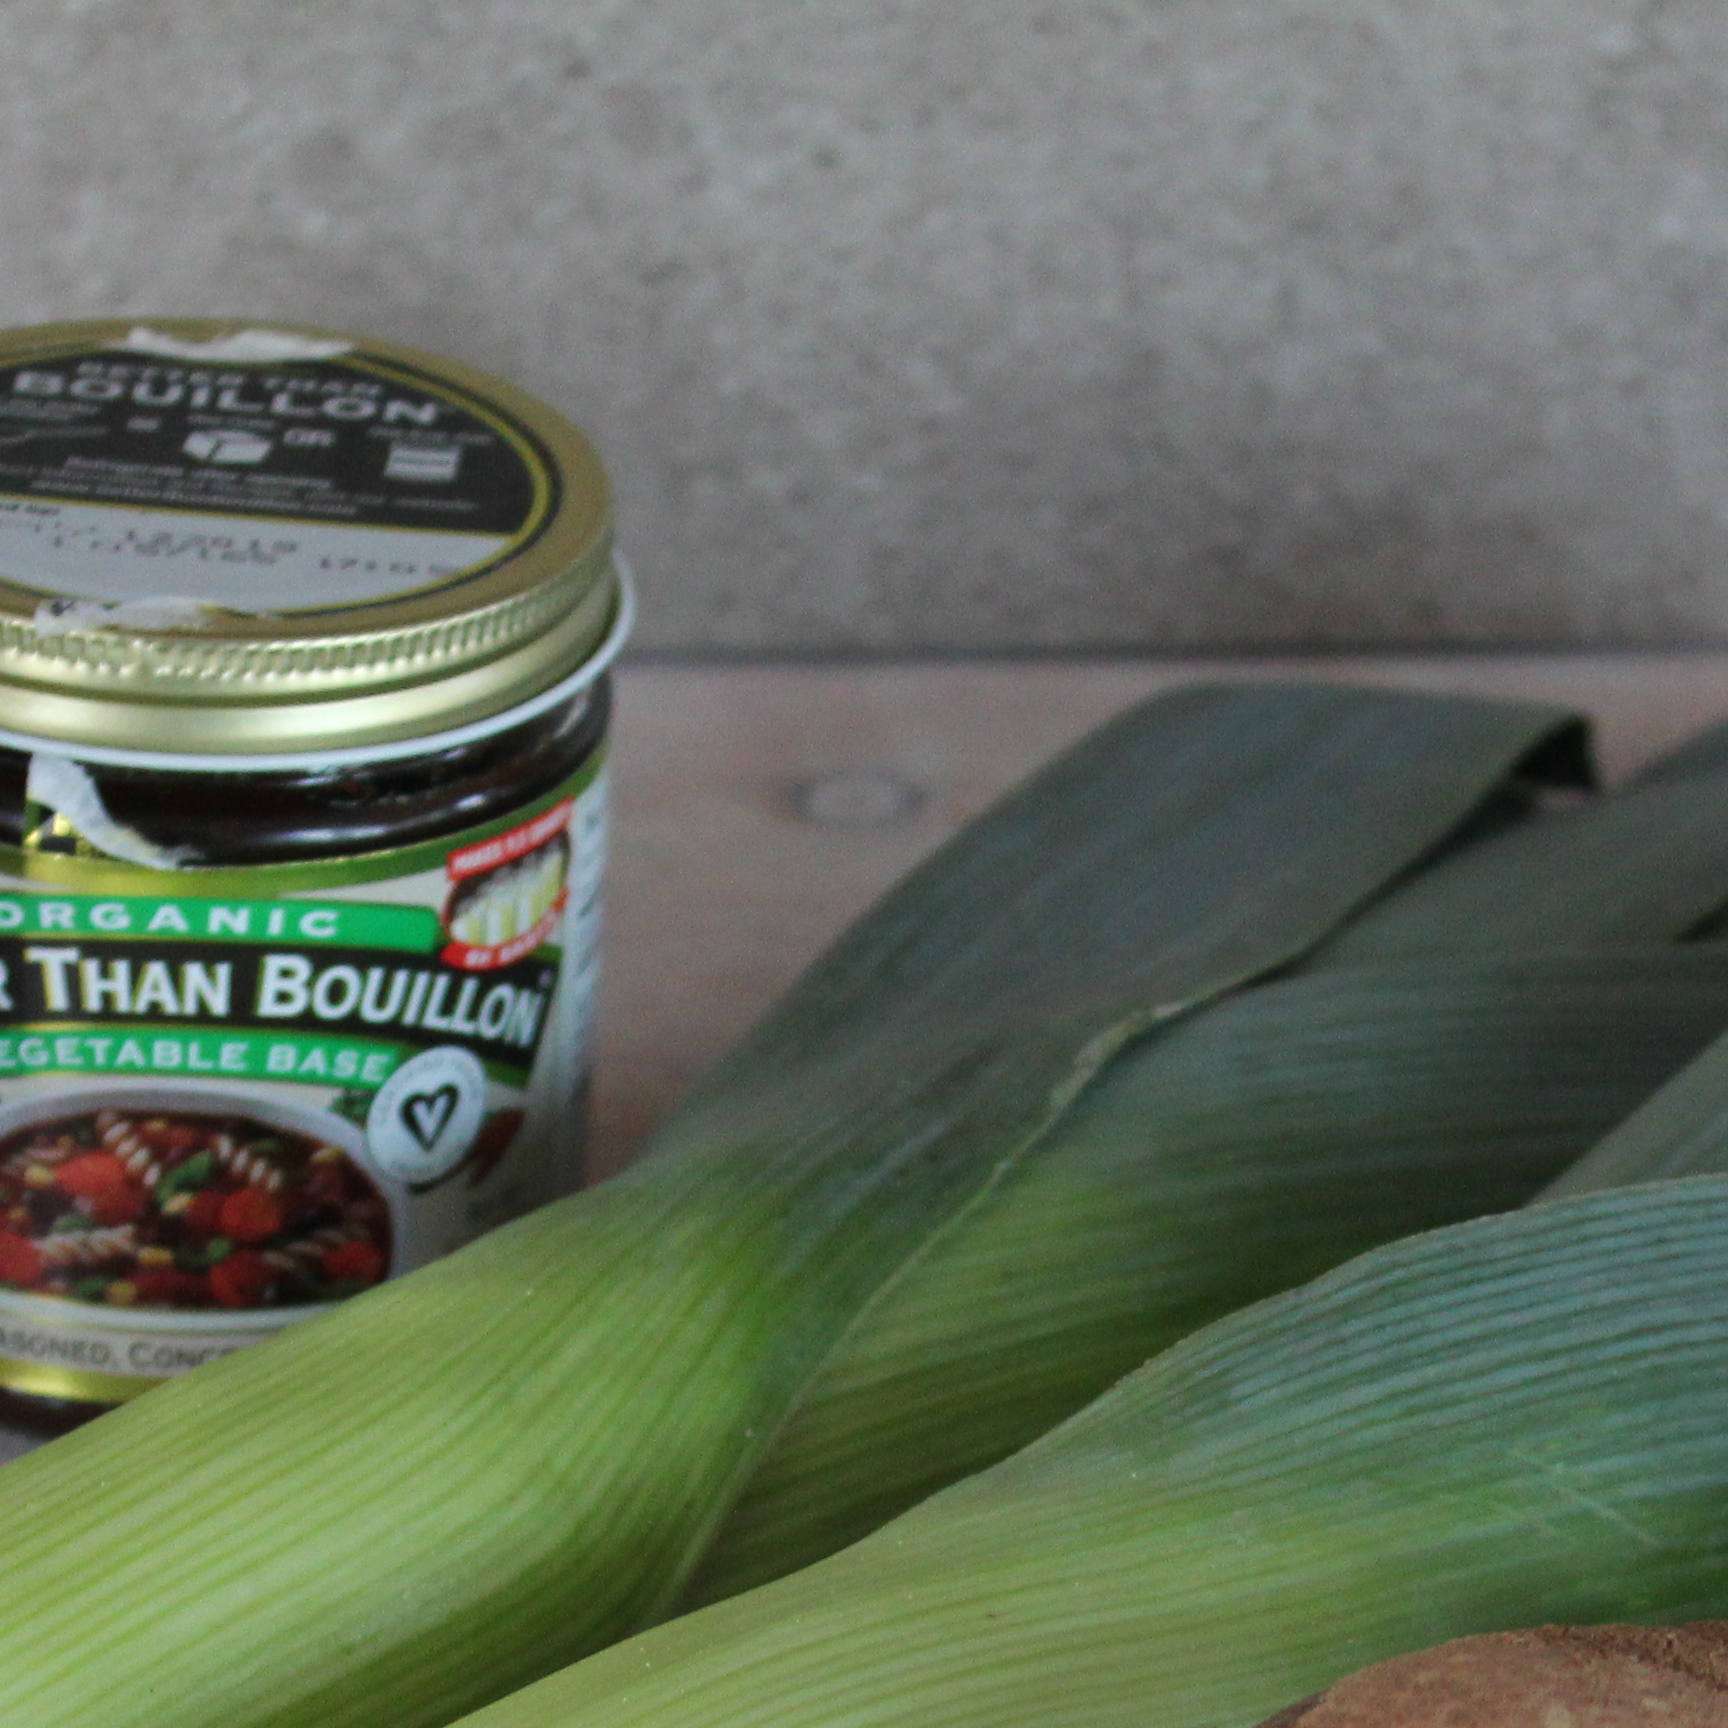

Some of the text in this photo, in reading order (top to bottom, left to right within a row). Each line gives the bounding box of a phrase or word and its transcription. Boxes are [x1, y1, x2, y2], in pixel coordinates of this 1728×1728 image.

[13, 369, 439, 425] BOUILLON
[24, 946, 230, 1018] THAN
[257, 951, 545, 1048] BOUILLON
[266, 1042, 390, 1083] BASE
